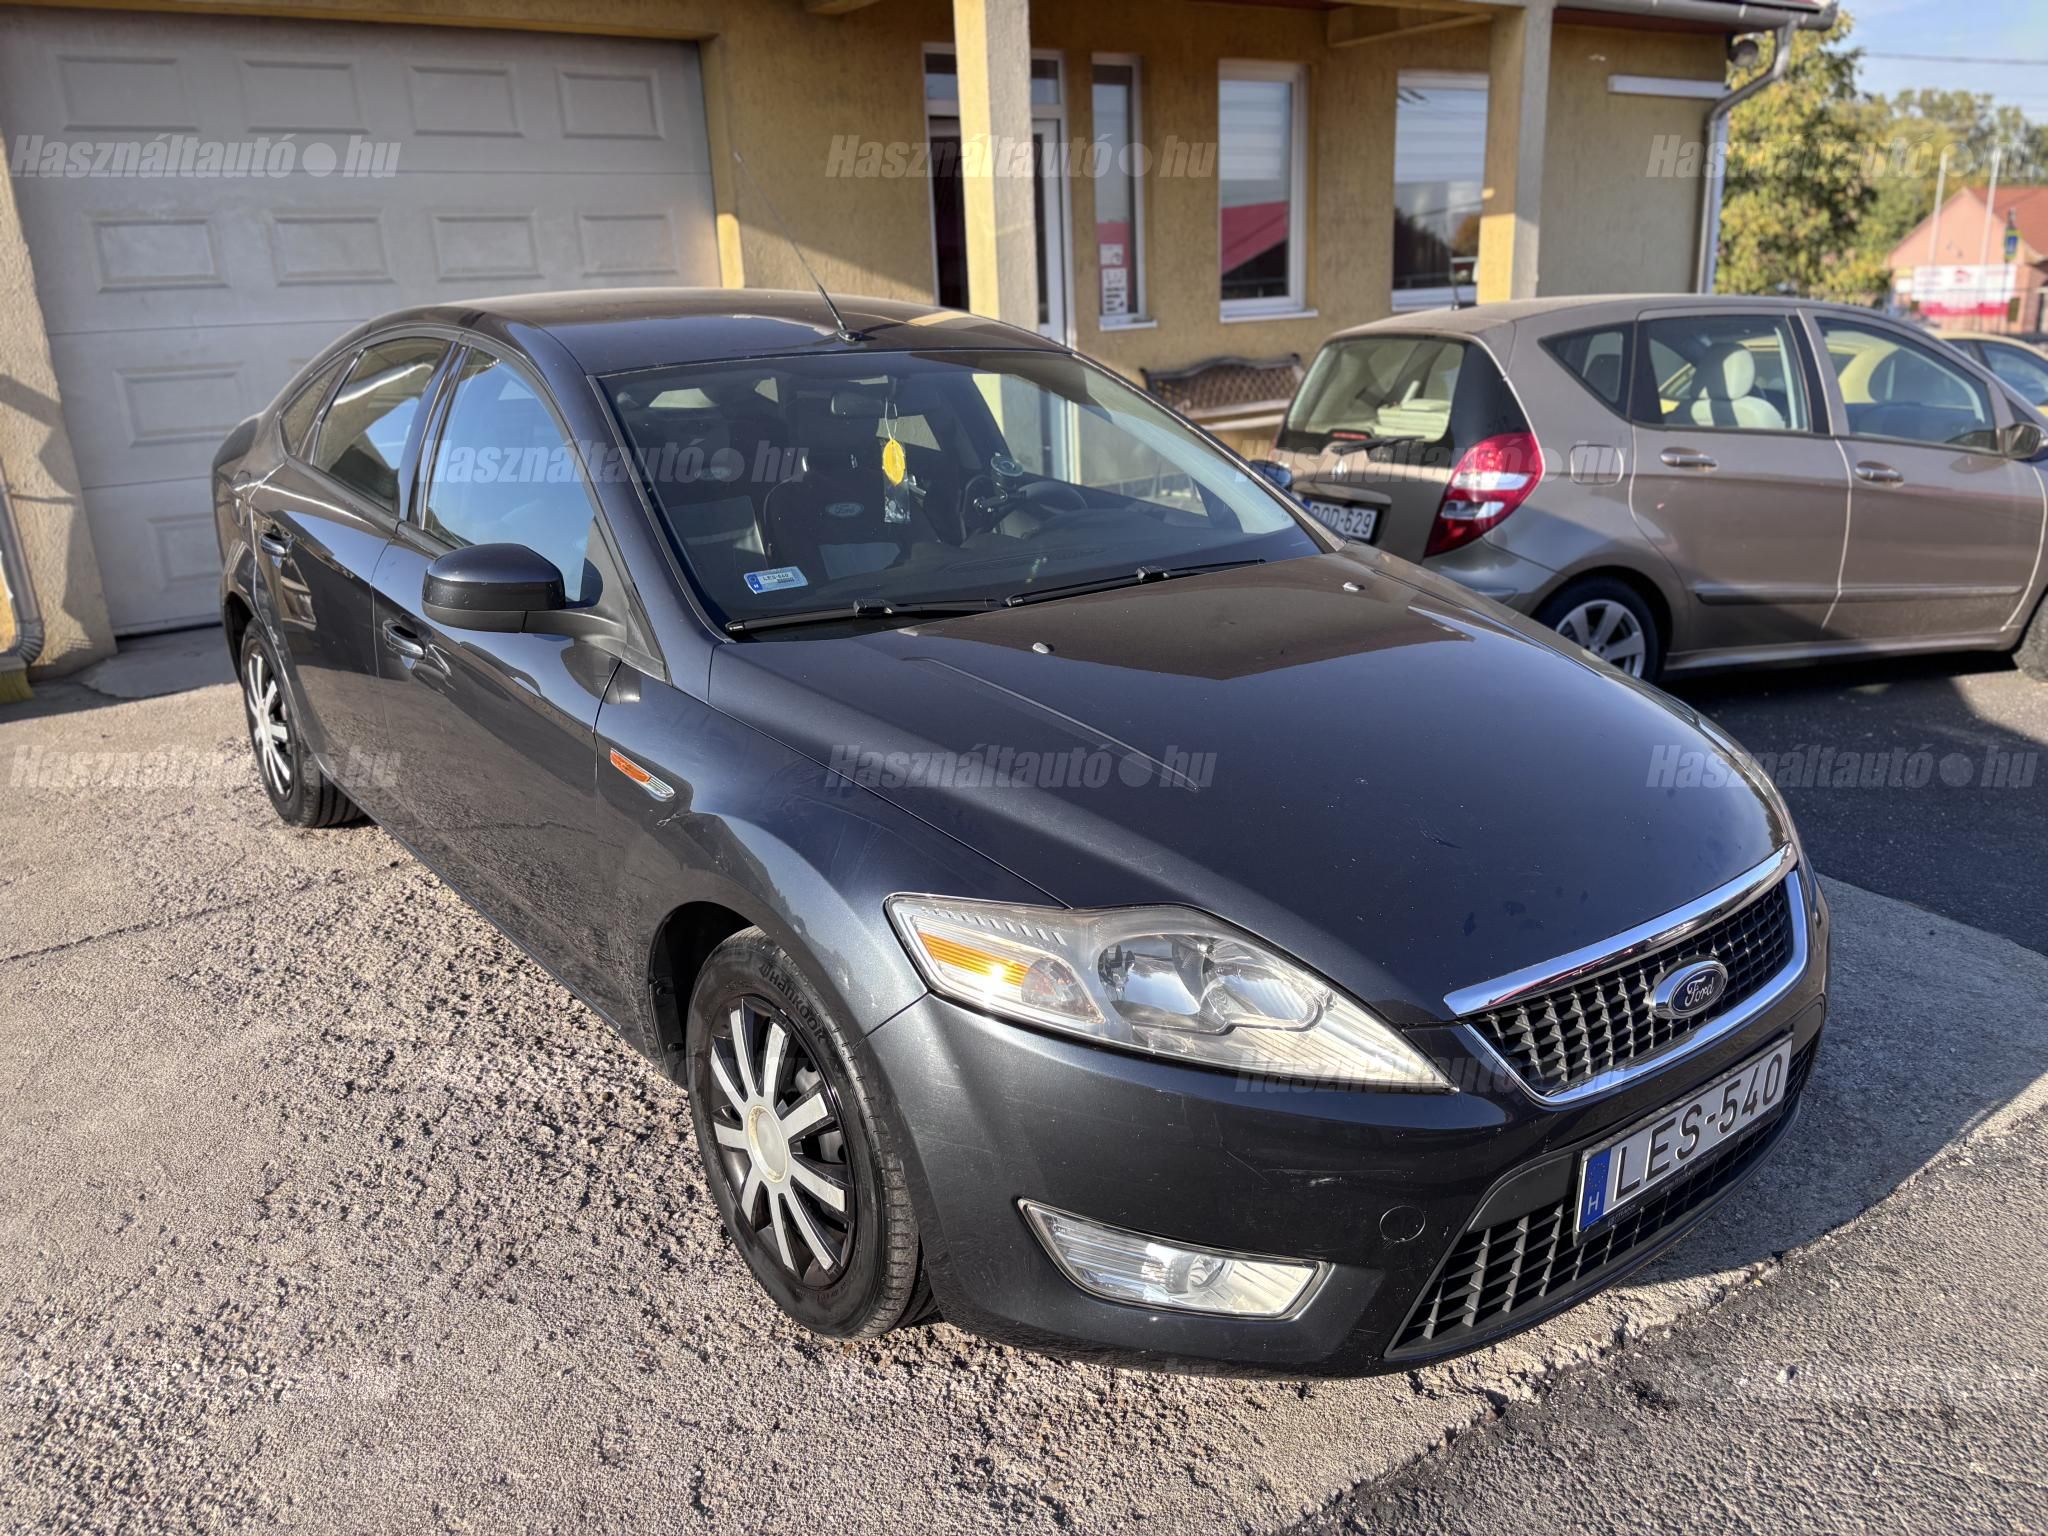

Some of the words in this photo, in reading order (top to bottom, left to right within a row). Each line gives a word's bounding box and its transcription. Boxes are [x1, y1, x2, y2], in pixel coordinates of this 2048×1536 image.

[1684, 975, 1714, 1007] Ford
[1613, 1052, 1783, 1202] LES-540
[1587, 1191, 1600, 1216] H
